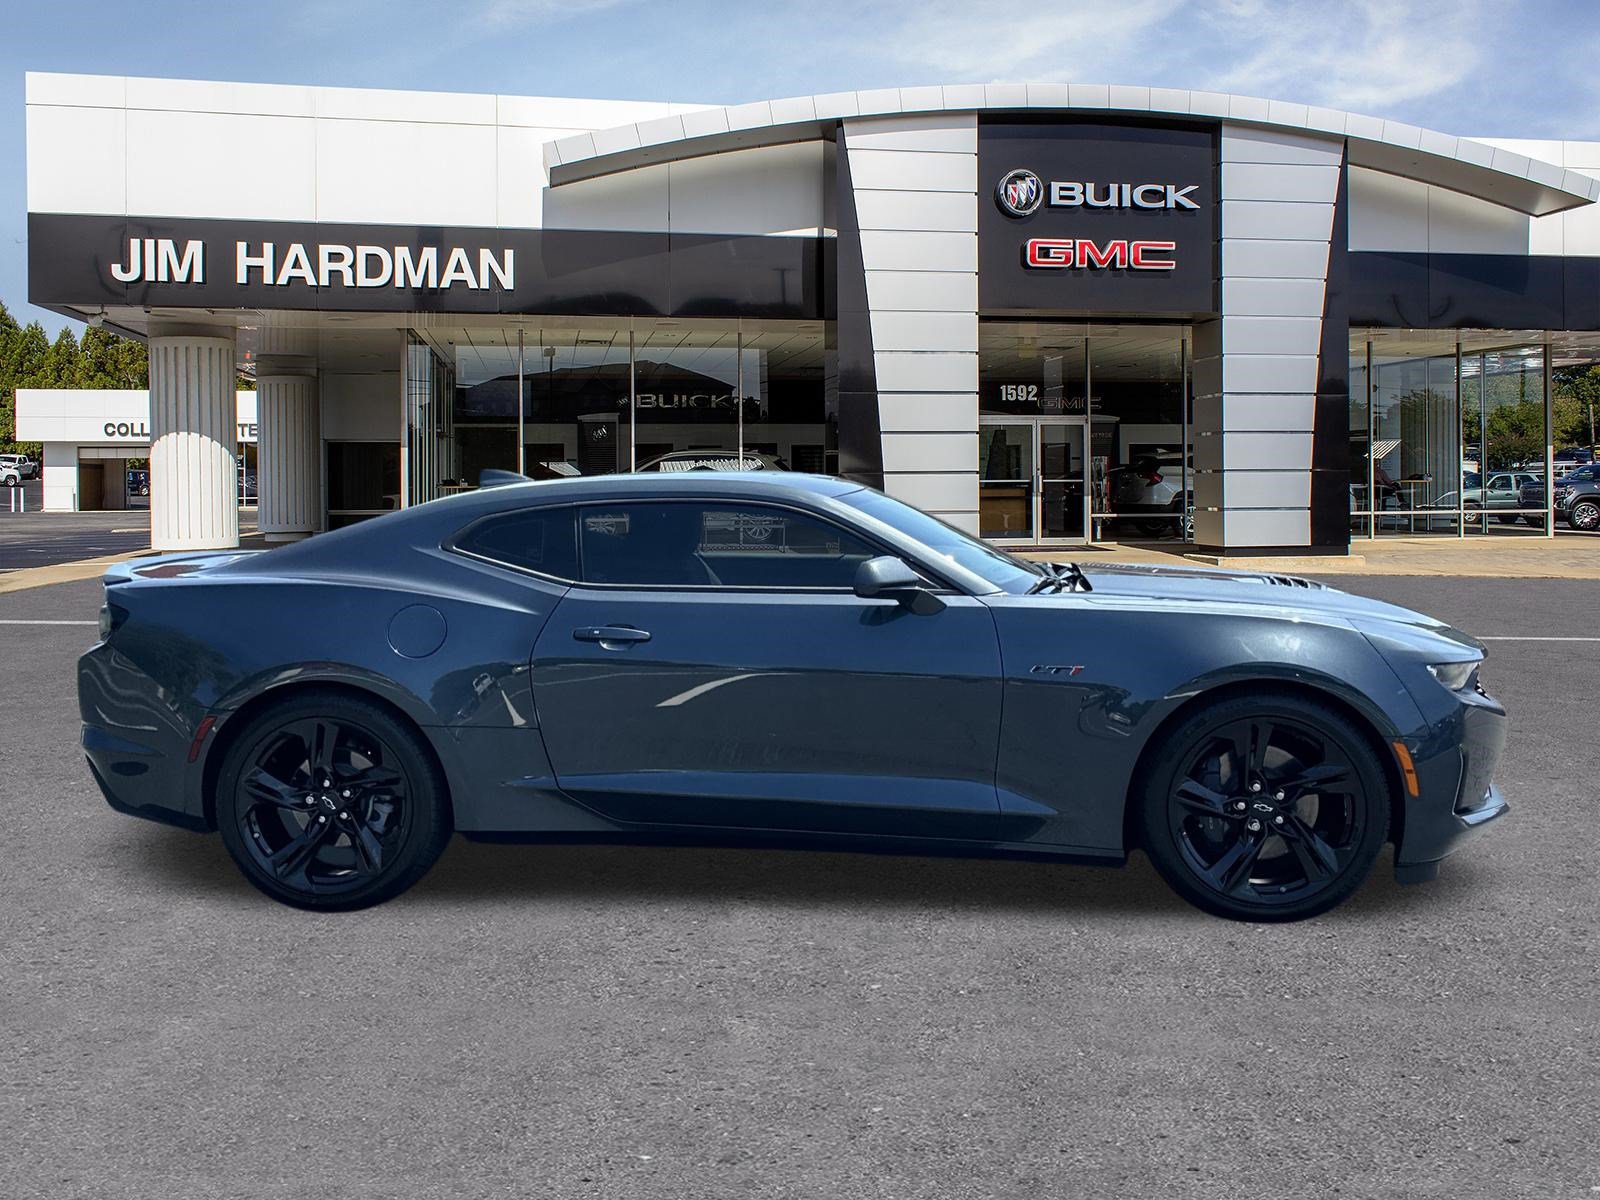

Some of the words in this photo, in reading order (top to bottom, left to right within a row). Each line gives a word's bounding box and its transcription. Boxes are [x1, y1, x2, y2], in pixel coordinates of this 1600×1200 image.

[1050, 181, 1200, 209] BUICK
[111, 238, 204, 284] JIM
[236, 240, 515, 291] HARDMAN
[1026, 238, 1176, 270] GMC
[636, 394, 731, 409] BUICK
[1000, 385, 1038, 401] 1592
